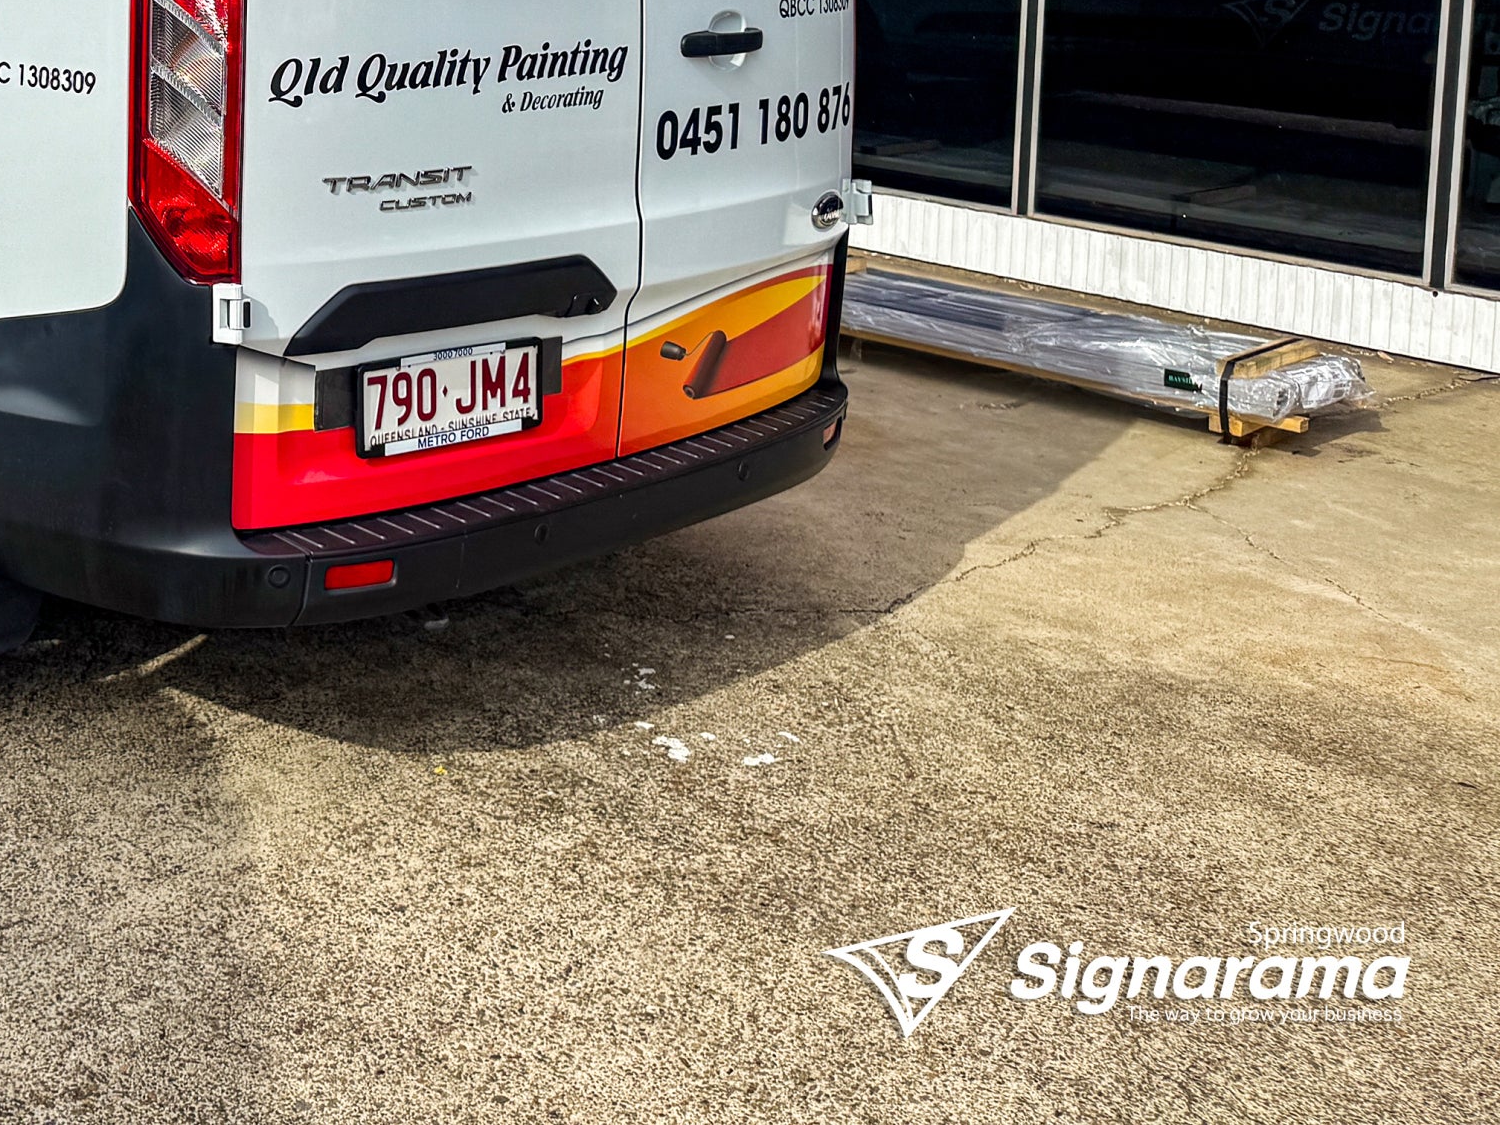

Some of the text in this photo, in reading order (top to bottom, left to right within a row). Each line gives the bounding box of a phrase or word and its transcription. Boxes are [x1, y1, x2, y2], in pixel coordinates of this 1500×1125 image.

[18, 63, 96, 95] 1308309
[268, 39, 629, 108] Qld Quality Painting
[501, 85, 604, 114] & Decorating
[656, 81, 851, 160] 0451 180 876
[321, 165, 473, 195] TRANSIT
[379, 191, 472, 213] CUSTOM
[367, 352, 531, 431] 790 JM4
[450, 413, 497, 432] SUNSHINE
[502, 406, 531, 421] STATE
[417, 426, 490, 450] METRO FORD
